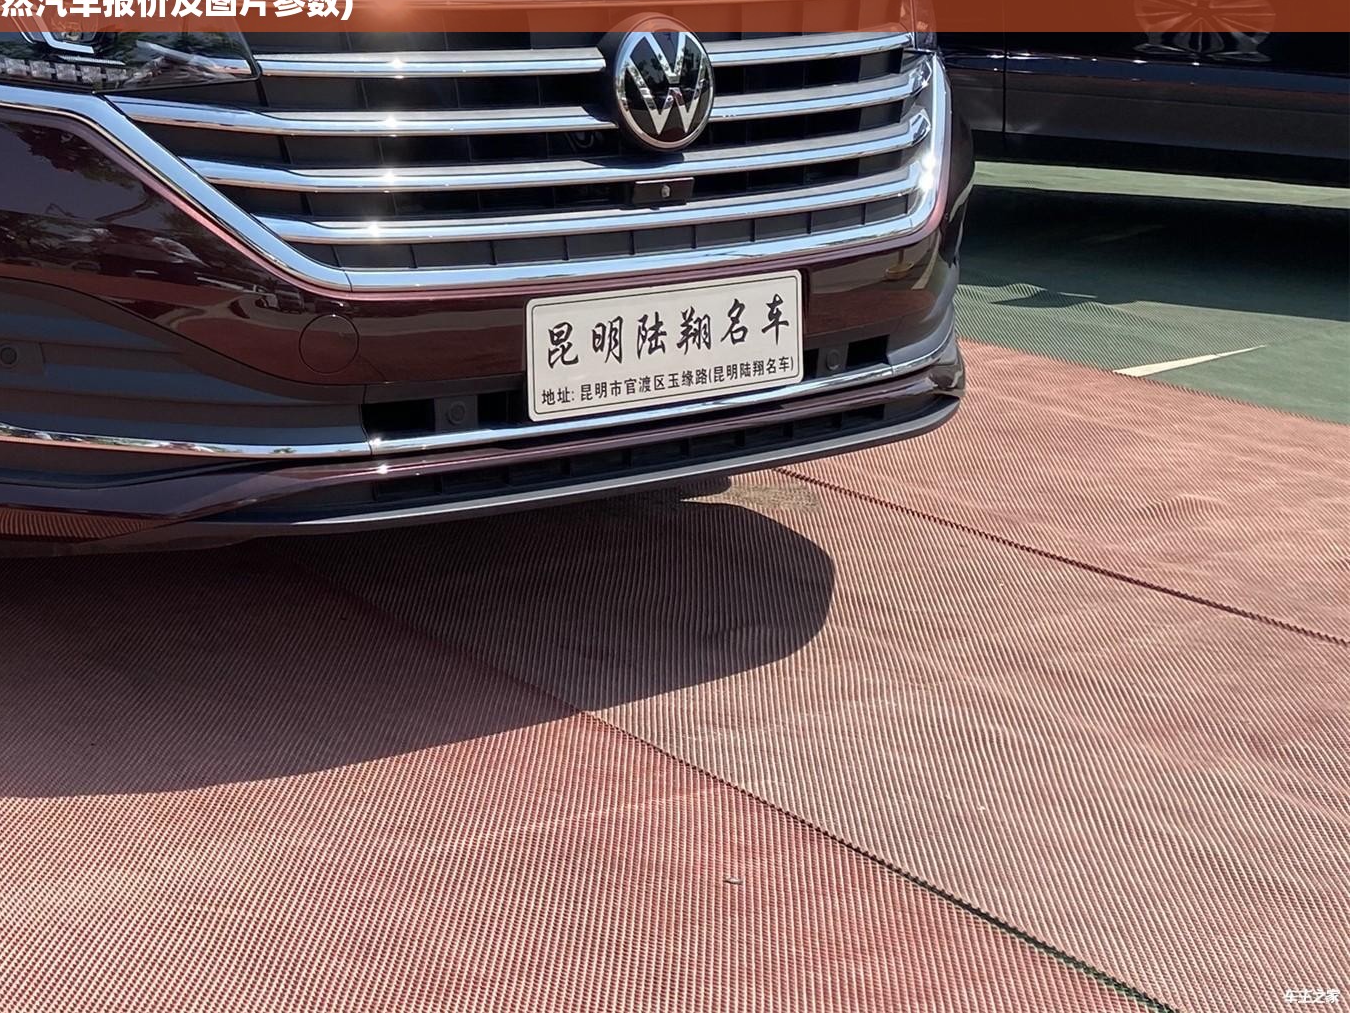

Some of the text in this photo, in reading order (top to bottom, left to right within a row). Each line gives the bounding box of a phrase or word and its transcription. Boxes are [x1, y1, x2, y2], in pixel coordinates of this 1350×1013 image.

[547, 293, 791, 369] 昆明陆翔名车
